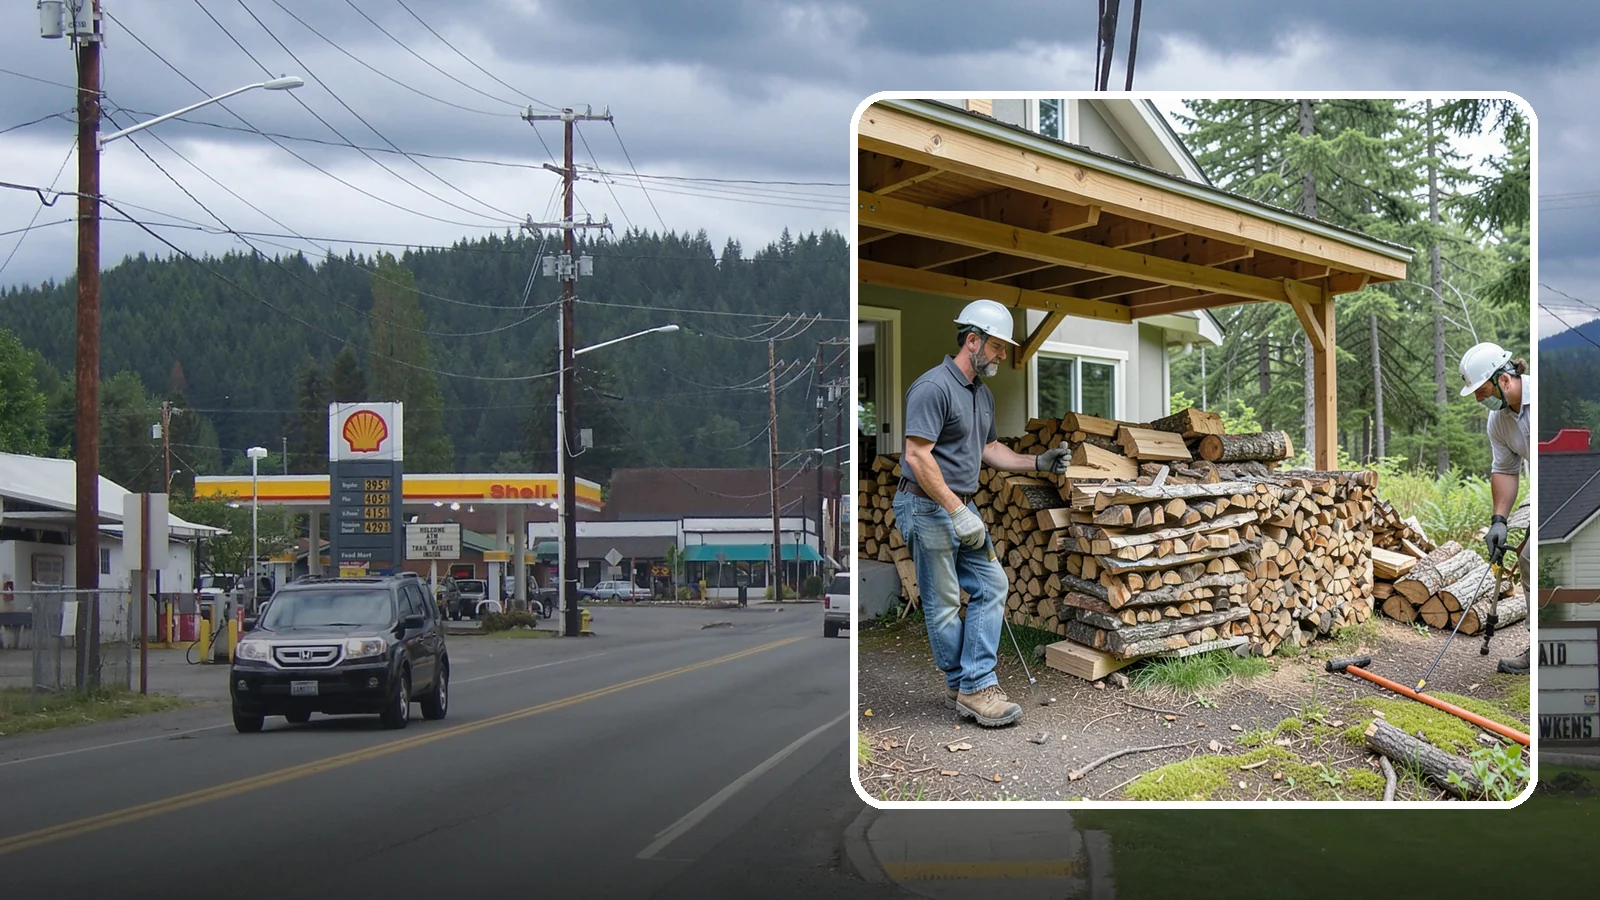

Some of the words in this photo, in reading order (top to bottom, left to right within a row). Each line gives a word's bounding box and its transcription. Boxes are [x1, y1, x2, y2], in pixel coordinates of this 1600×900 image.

[366, 480, 383, 490] 395
[490, 484, 547, 498] Shell
[366, 494, 383, 504] 405
[366, 508, 383, 518] 415
[366, 522, 383, 532] 429
